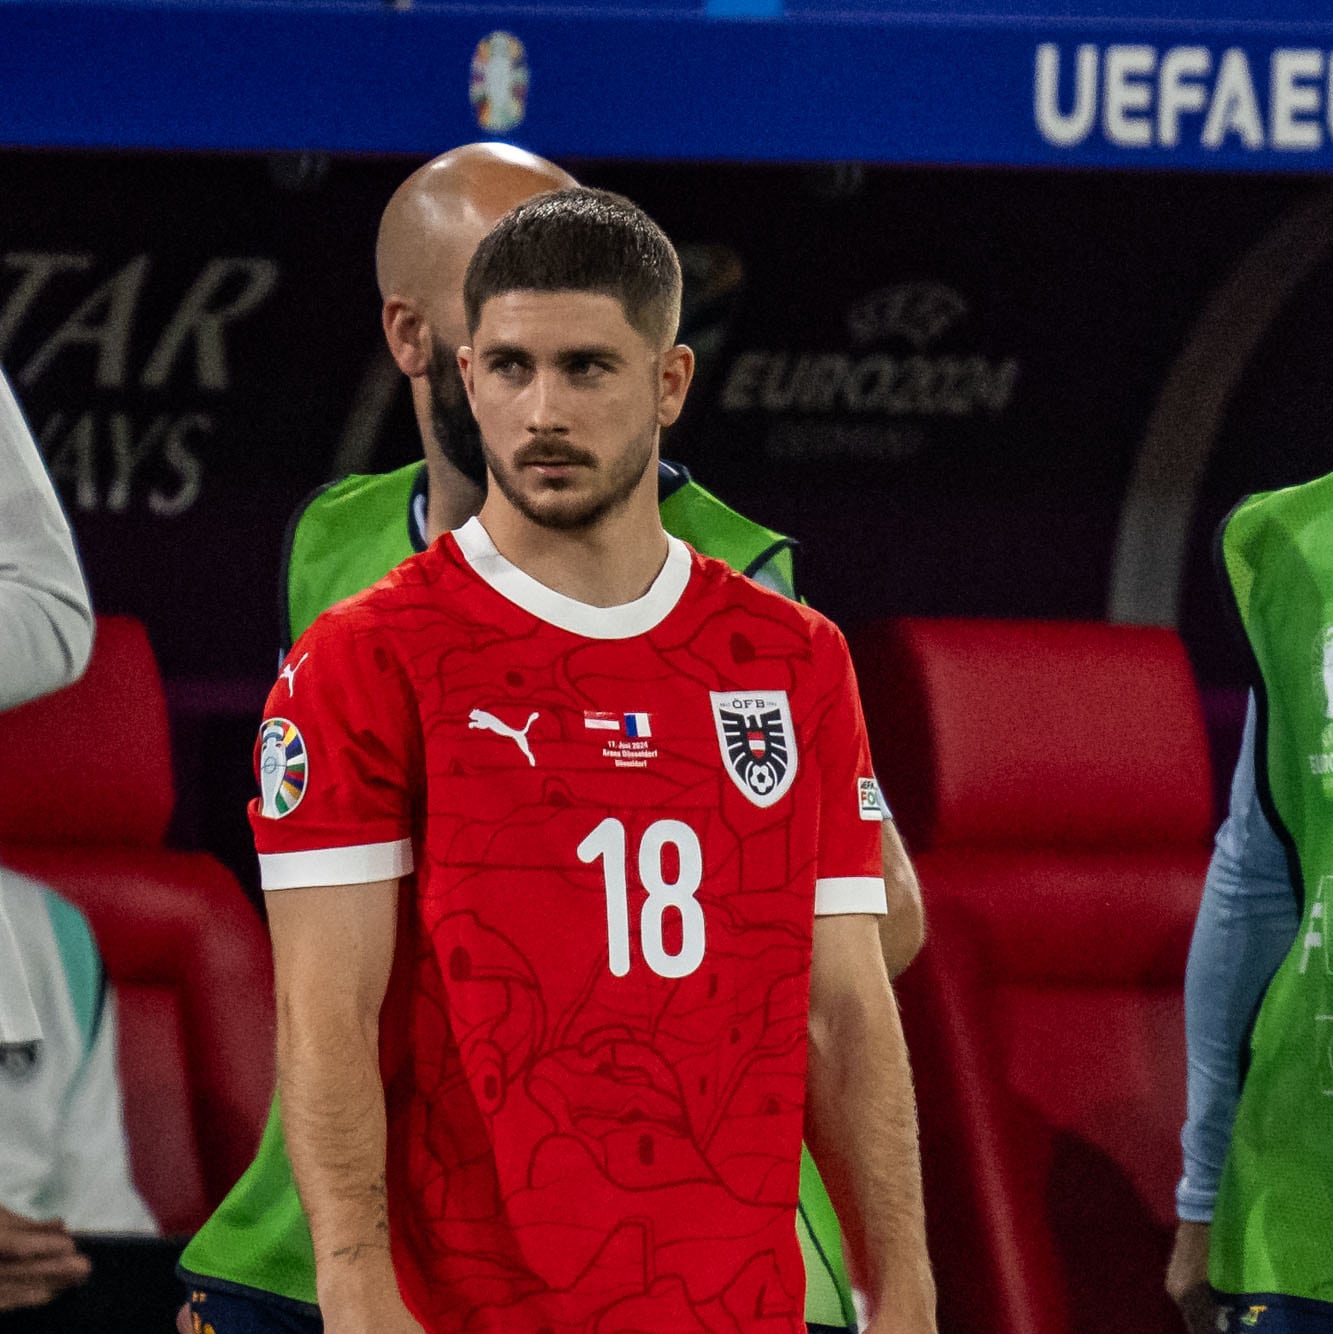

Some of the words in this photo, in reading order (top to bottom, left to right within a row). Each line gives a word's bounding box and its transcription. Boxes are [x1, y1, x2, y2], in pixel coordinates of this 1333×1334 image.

[40, 411, 214, 518] AYS
[732, 698, 765, 709] ÖFB
[576, 817, 706, 978] 18
